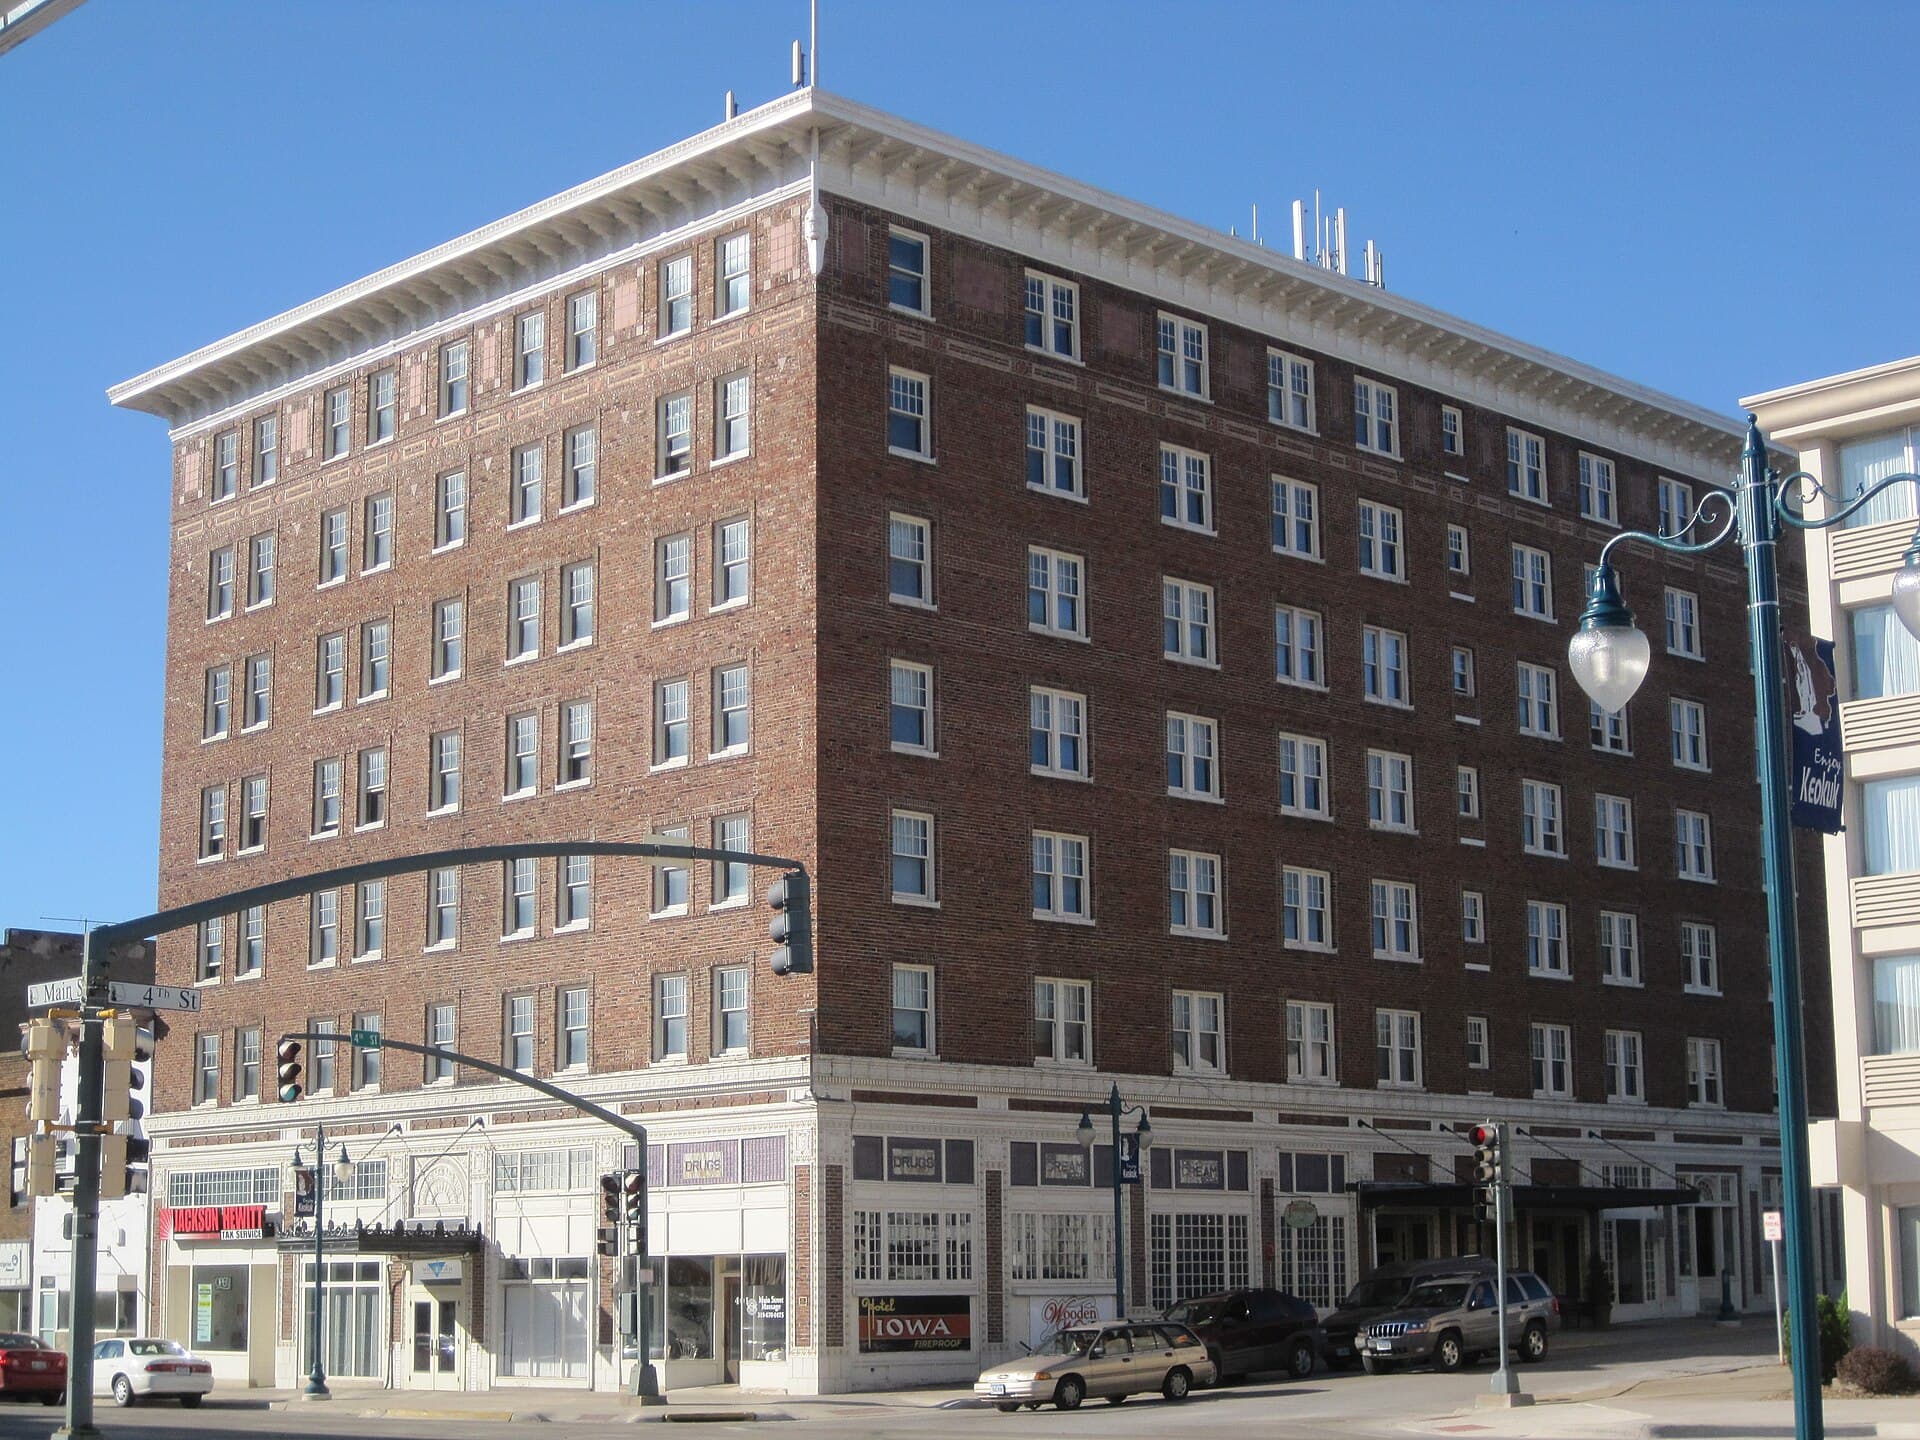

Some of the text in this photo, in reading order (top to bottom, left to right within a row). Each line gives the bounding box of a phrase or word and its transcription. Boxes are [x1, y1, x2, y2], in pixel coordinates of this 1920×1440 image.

[1814, 747, 1841, 776] Enjoy
[1800, 766, 1840, 809] Keokuk
[44, 982, 72, 1003] Main
[179, 989, 198, 1010] St
[685, 1159, 721, 1172] DRUGS
[893, 1155, 934, 1169] DRUGS
[174, 1205, 264, 1233] JACKSON HEWITT
[222, 1230, 262, 1240] TAX SERVICE
[862, 1297, 896, 1312] Hotel
[1043, 1299, 1097, 1325] Wooden
[876, 1317, 952, 1337] IOWA
